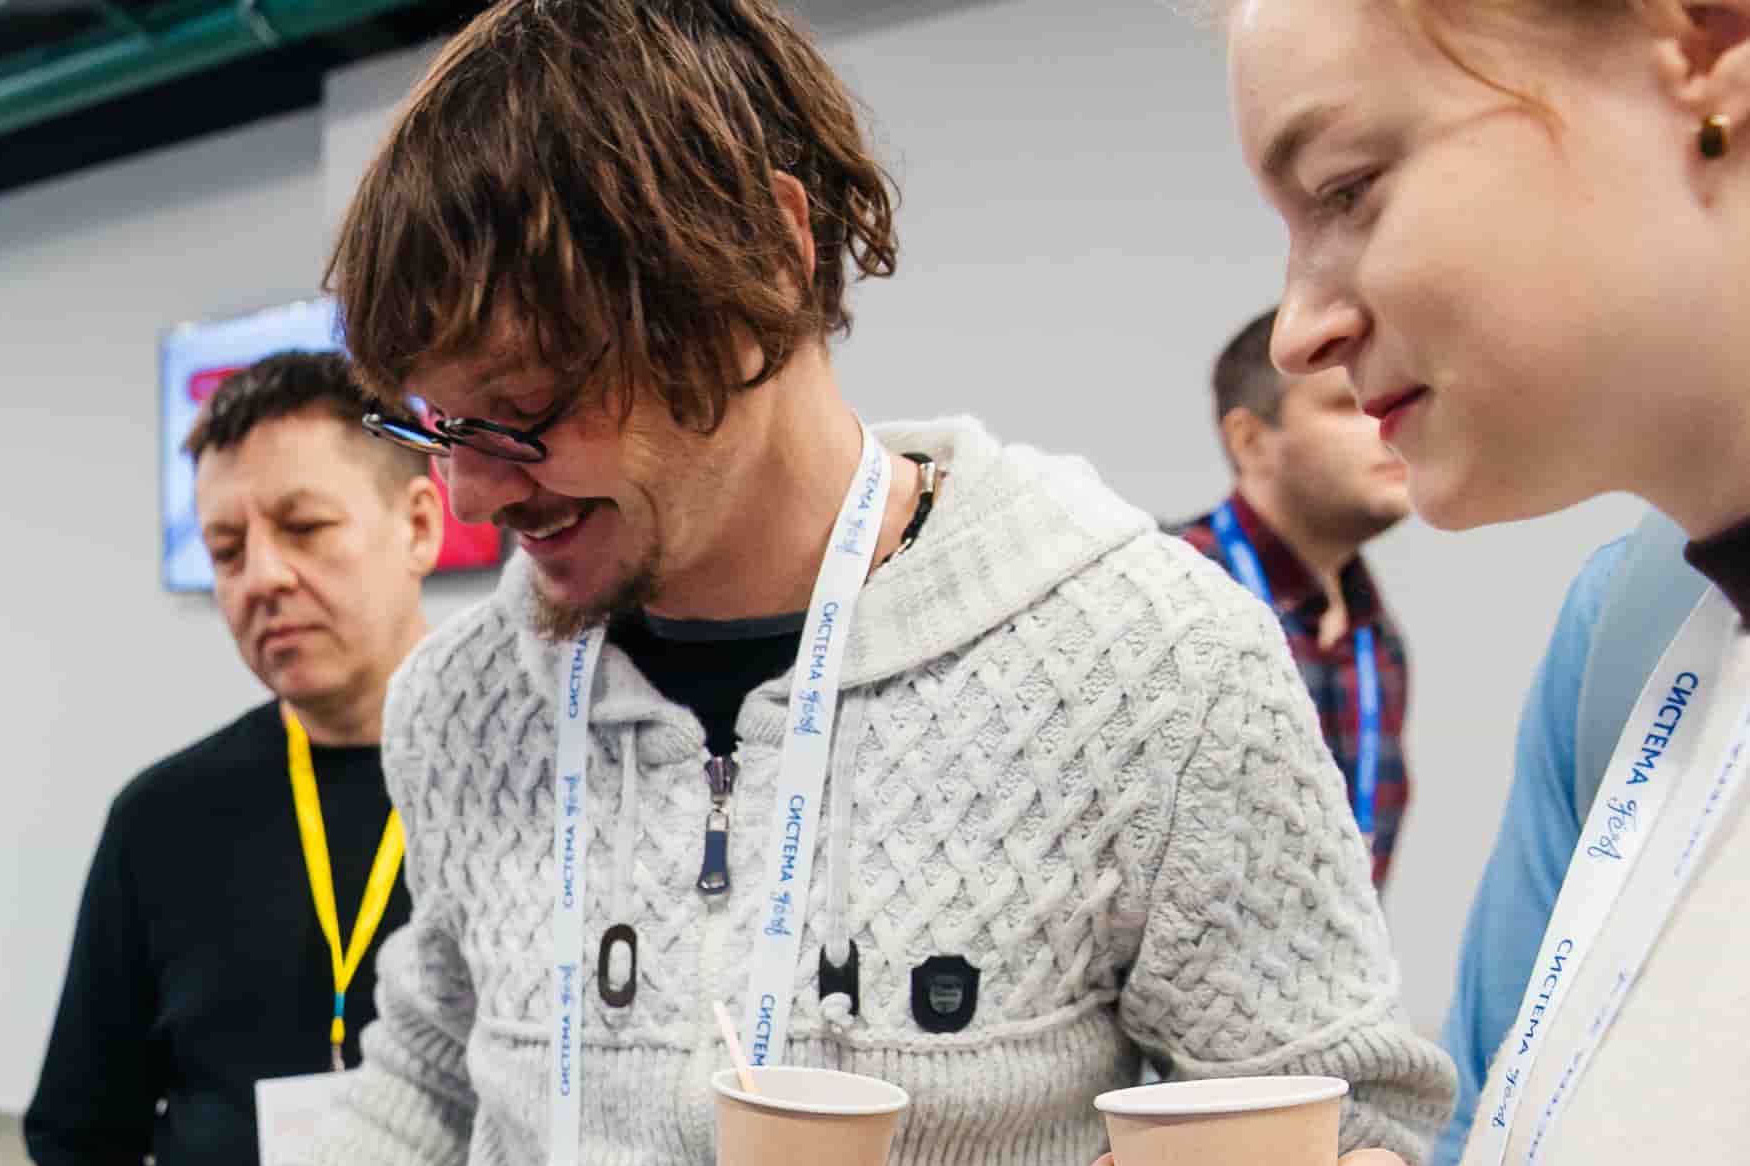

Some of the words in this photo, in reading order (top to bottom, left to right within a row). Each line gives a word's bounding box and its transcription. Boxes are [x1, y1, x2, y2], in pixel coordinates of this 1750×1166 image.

[809, 601, 839, 681] СИСТЕМА
[1625, 671, 1699, 785] СИСТЕМА
[562, 824, 576, 909] СИСТЕМА
[779, 795, 805, 882] СИСТЕМА
[750, 993, 776, 1067] СИСТЕМ
[1517, 938, 1574, 1056] СИСТЕМА
[560, 1014, 571, 1093] СИСТЕМА
